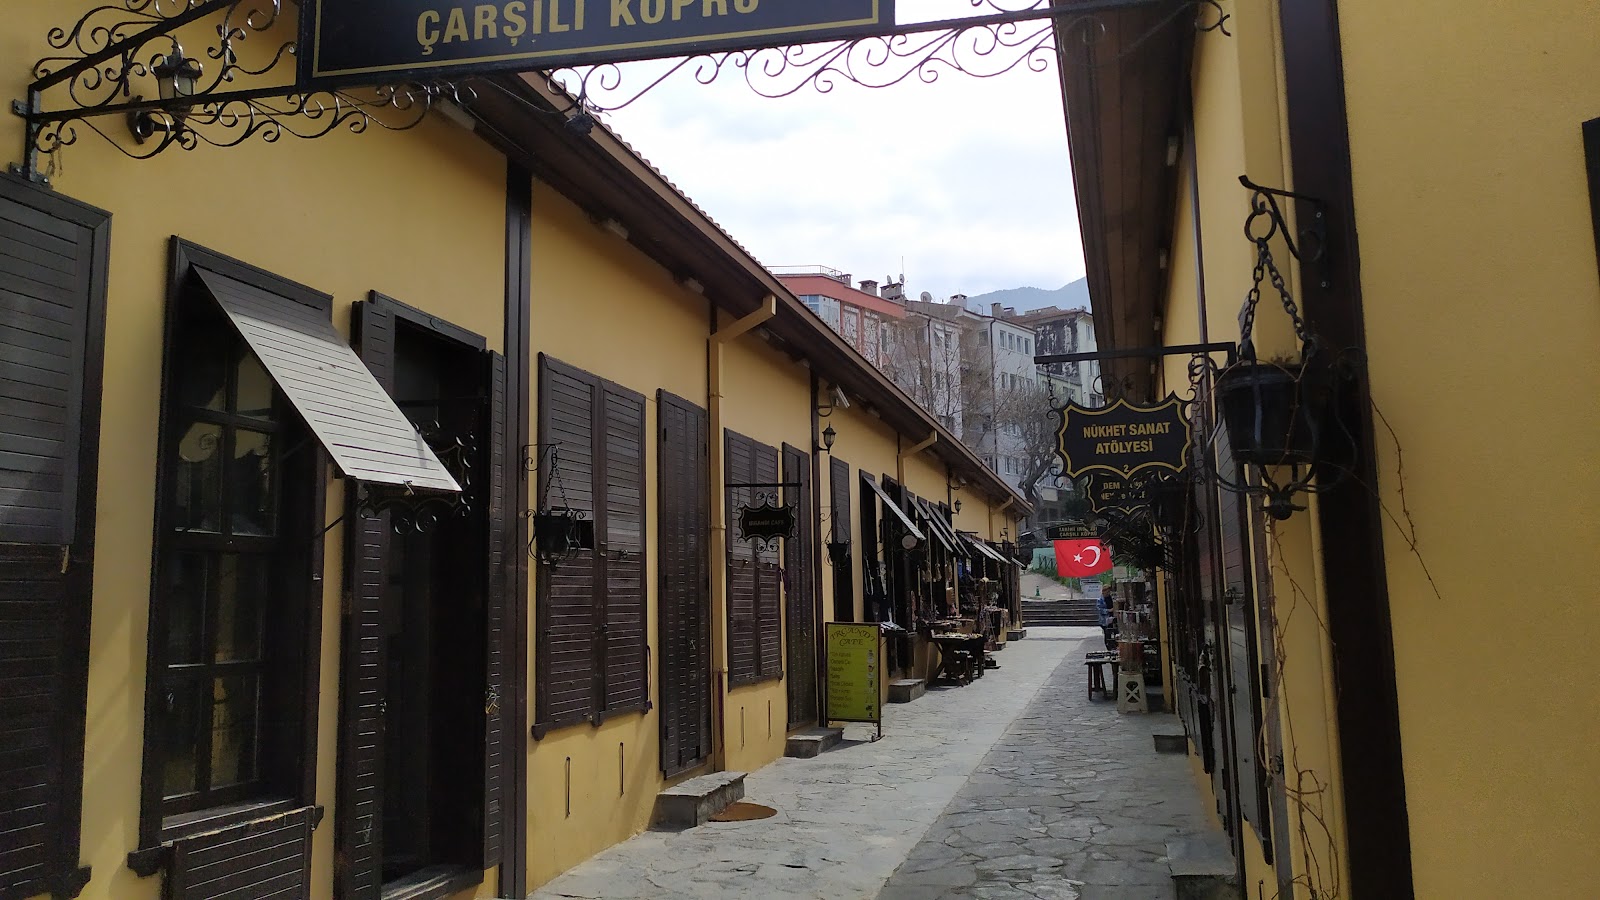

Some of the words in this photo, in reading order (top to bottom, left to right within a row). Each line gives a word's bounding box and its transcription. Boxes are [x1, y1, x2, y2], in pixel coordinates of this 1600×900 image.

[416, 0, 585, 56] ÇARŞILI
[1083, 424, 1126, 438] NÜKHET
[1129, 422, 1170, 435] SANAT
[1095, 438, 1153, 455] ATÖLYESİ
[1123, 464, 1129, 473] 2
[1103, 482, 1121, 490] DEM
[839, 638, 864, 647] CAFE
